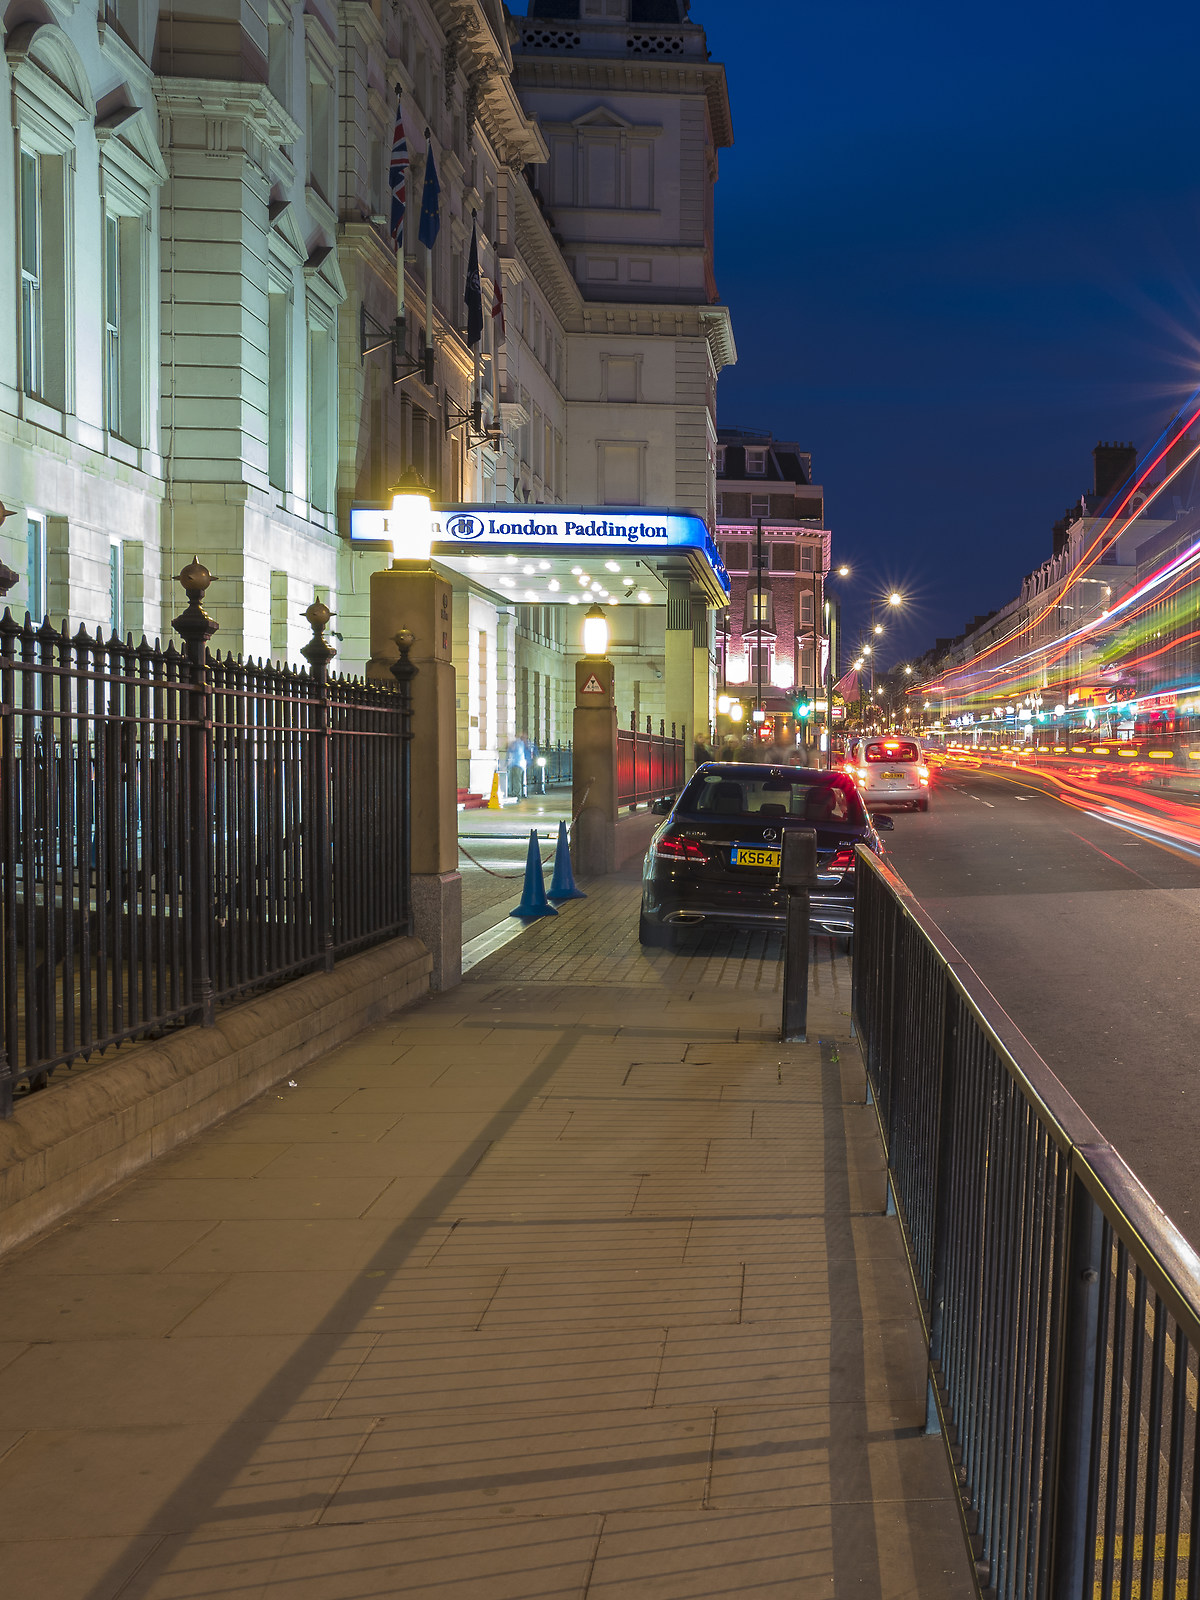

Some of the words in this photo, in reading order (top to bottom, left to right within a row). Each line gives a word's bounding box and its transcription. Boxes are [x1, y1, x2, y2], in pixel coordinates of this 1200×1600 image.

[488, 519, 559, 536] London
[564, 521, 668, 543] Paddington
[739, 851, 773, 865] KS64
